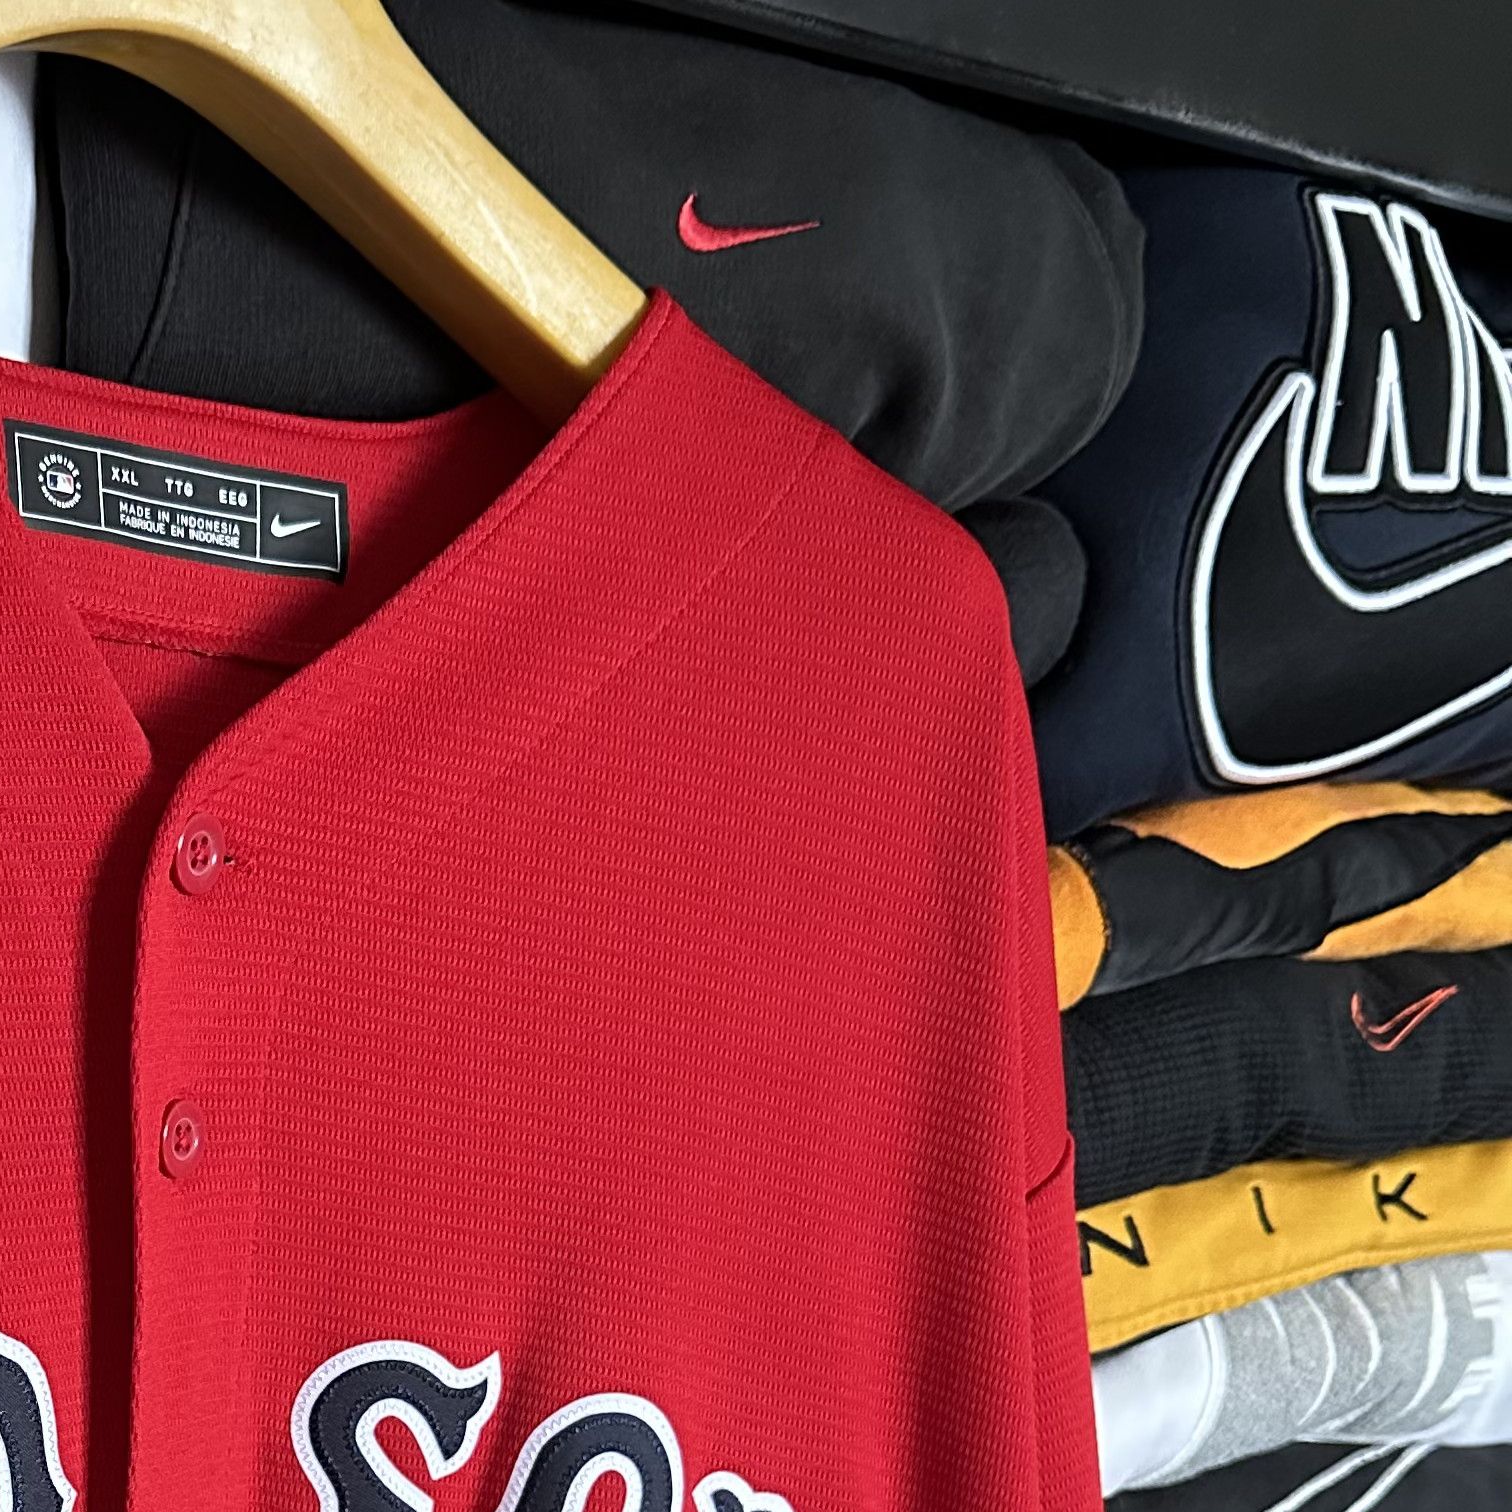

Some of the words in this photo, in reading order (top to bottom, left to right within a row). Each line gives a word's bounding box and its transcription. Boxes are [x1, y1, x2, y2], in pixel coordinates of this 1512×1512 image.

[1306, 193, 1512, 496] NI
[111, 466, 139, 487] XXL
[119, 501, 151, 520] MADE
[157, 509, 170, 524] IN
[176, 513, 241, 537] INDONESIA
[119, 513, 166, 535] FABRIQUE
[170, 524, 185, 539] EN
[188, 529, 241, 549] INDONESIE
